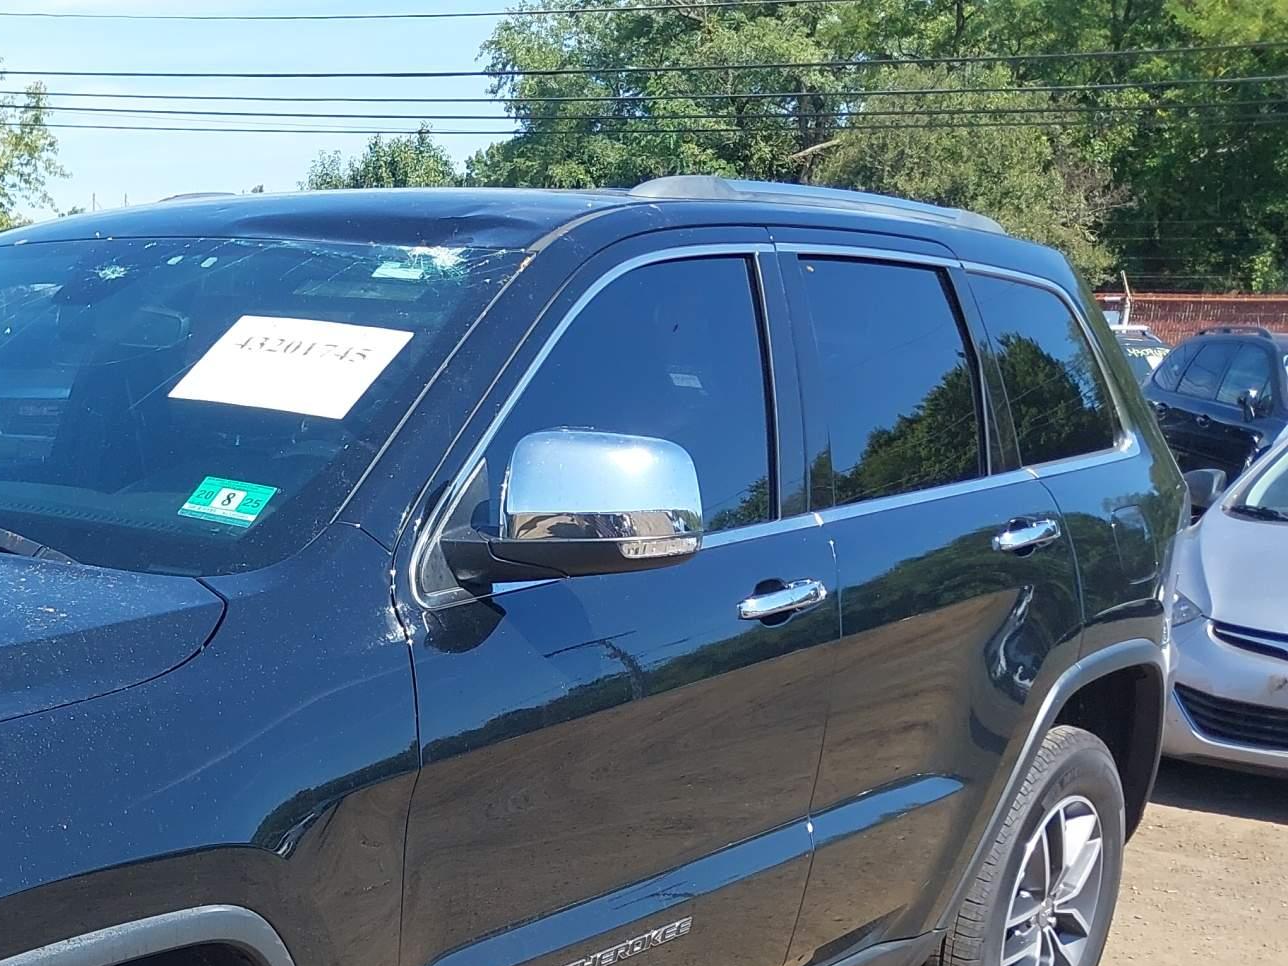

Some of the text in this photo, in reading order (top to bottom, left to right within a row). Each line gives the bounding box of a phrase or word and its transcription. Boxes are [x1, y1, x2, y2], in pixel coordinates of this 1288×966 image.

[234, 336, 376, 363] 43201745
[196, 489, 263, 509] 20 8 25
